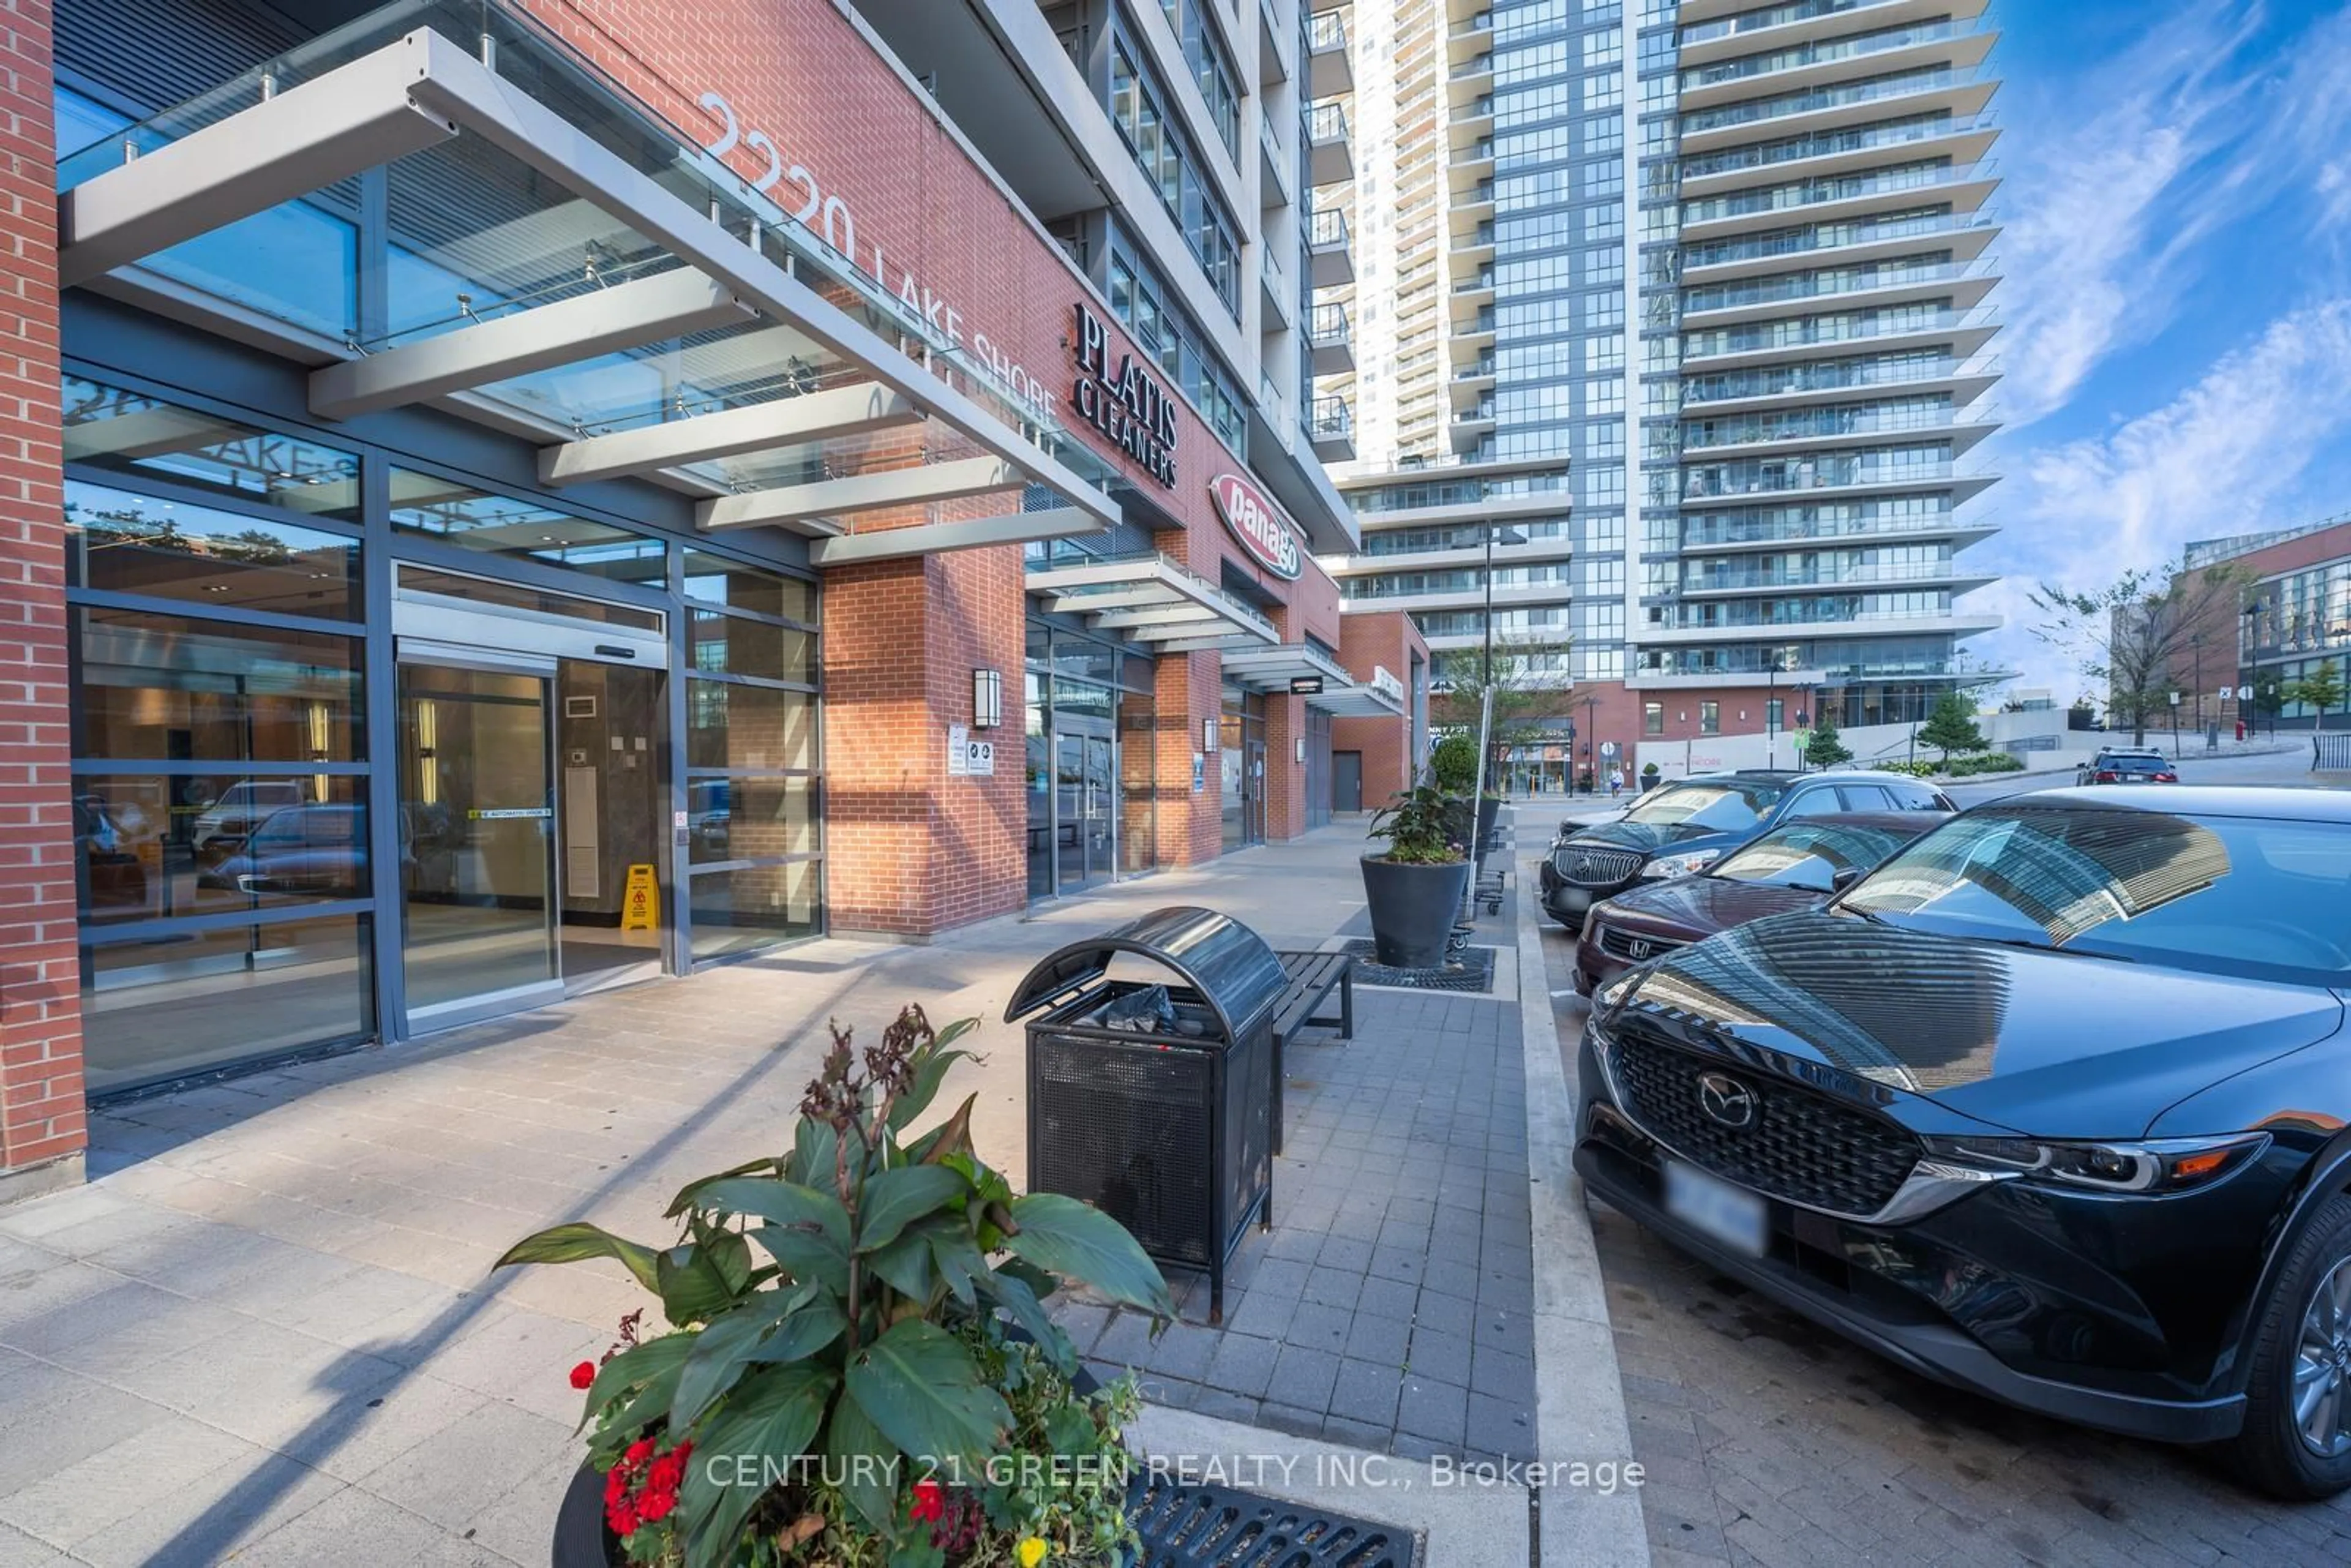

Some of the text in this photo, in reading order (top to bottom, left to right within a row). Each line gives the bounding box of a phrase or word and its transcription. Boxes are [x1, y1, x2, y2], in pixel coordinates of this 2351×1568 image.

[698, 92, 1056, 424] 2220 LAKE SHORE
[1074, 302, 1177, 452] PLATIS
[1074, 377, 1177, 489] CLEANERS
[1229, 482, 1297, 574] panago
